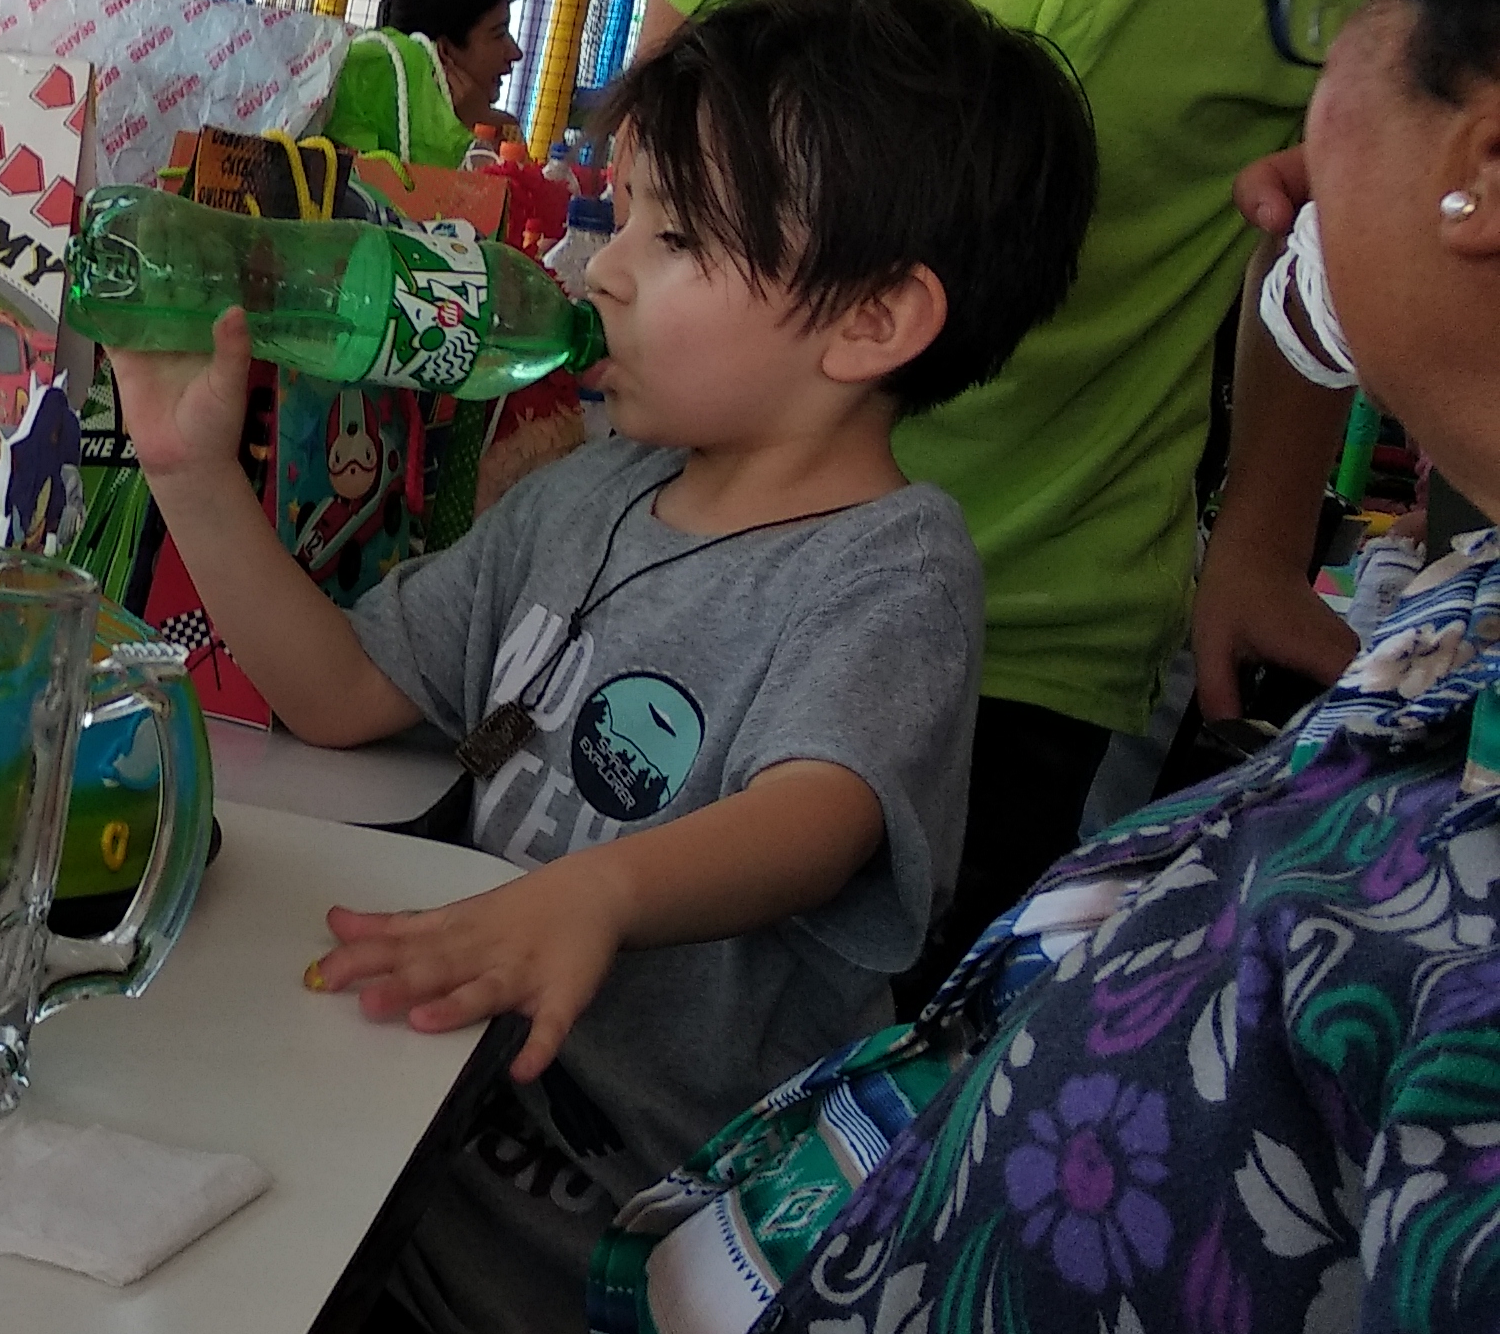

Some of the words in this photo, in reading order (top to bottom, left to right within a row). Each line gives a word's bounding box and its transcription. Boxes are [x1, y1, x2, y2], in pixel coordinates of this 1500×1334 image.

[53, 19, 97, 58] SEARS
[130, 25, 174, 64] SEARS
[208, 28, 253, 71] SEARS
[156, 72, 200, 114] SEARS
[235, 80, 280, 120] SEARS
[104, 114, 148, 156] SEARS
[80, 436, 116, 459] THE
[577, 735, 637, 811] EXPLORER
[596, 736, 638, 787] SPACE
